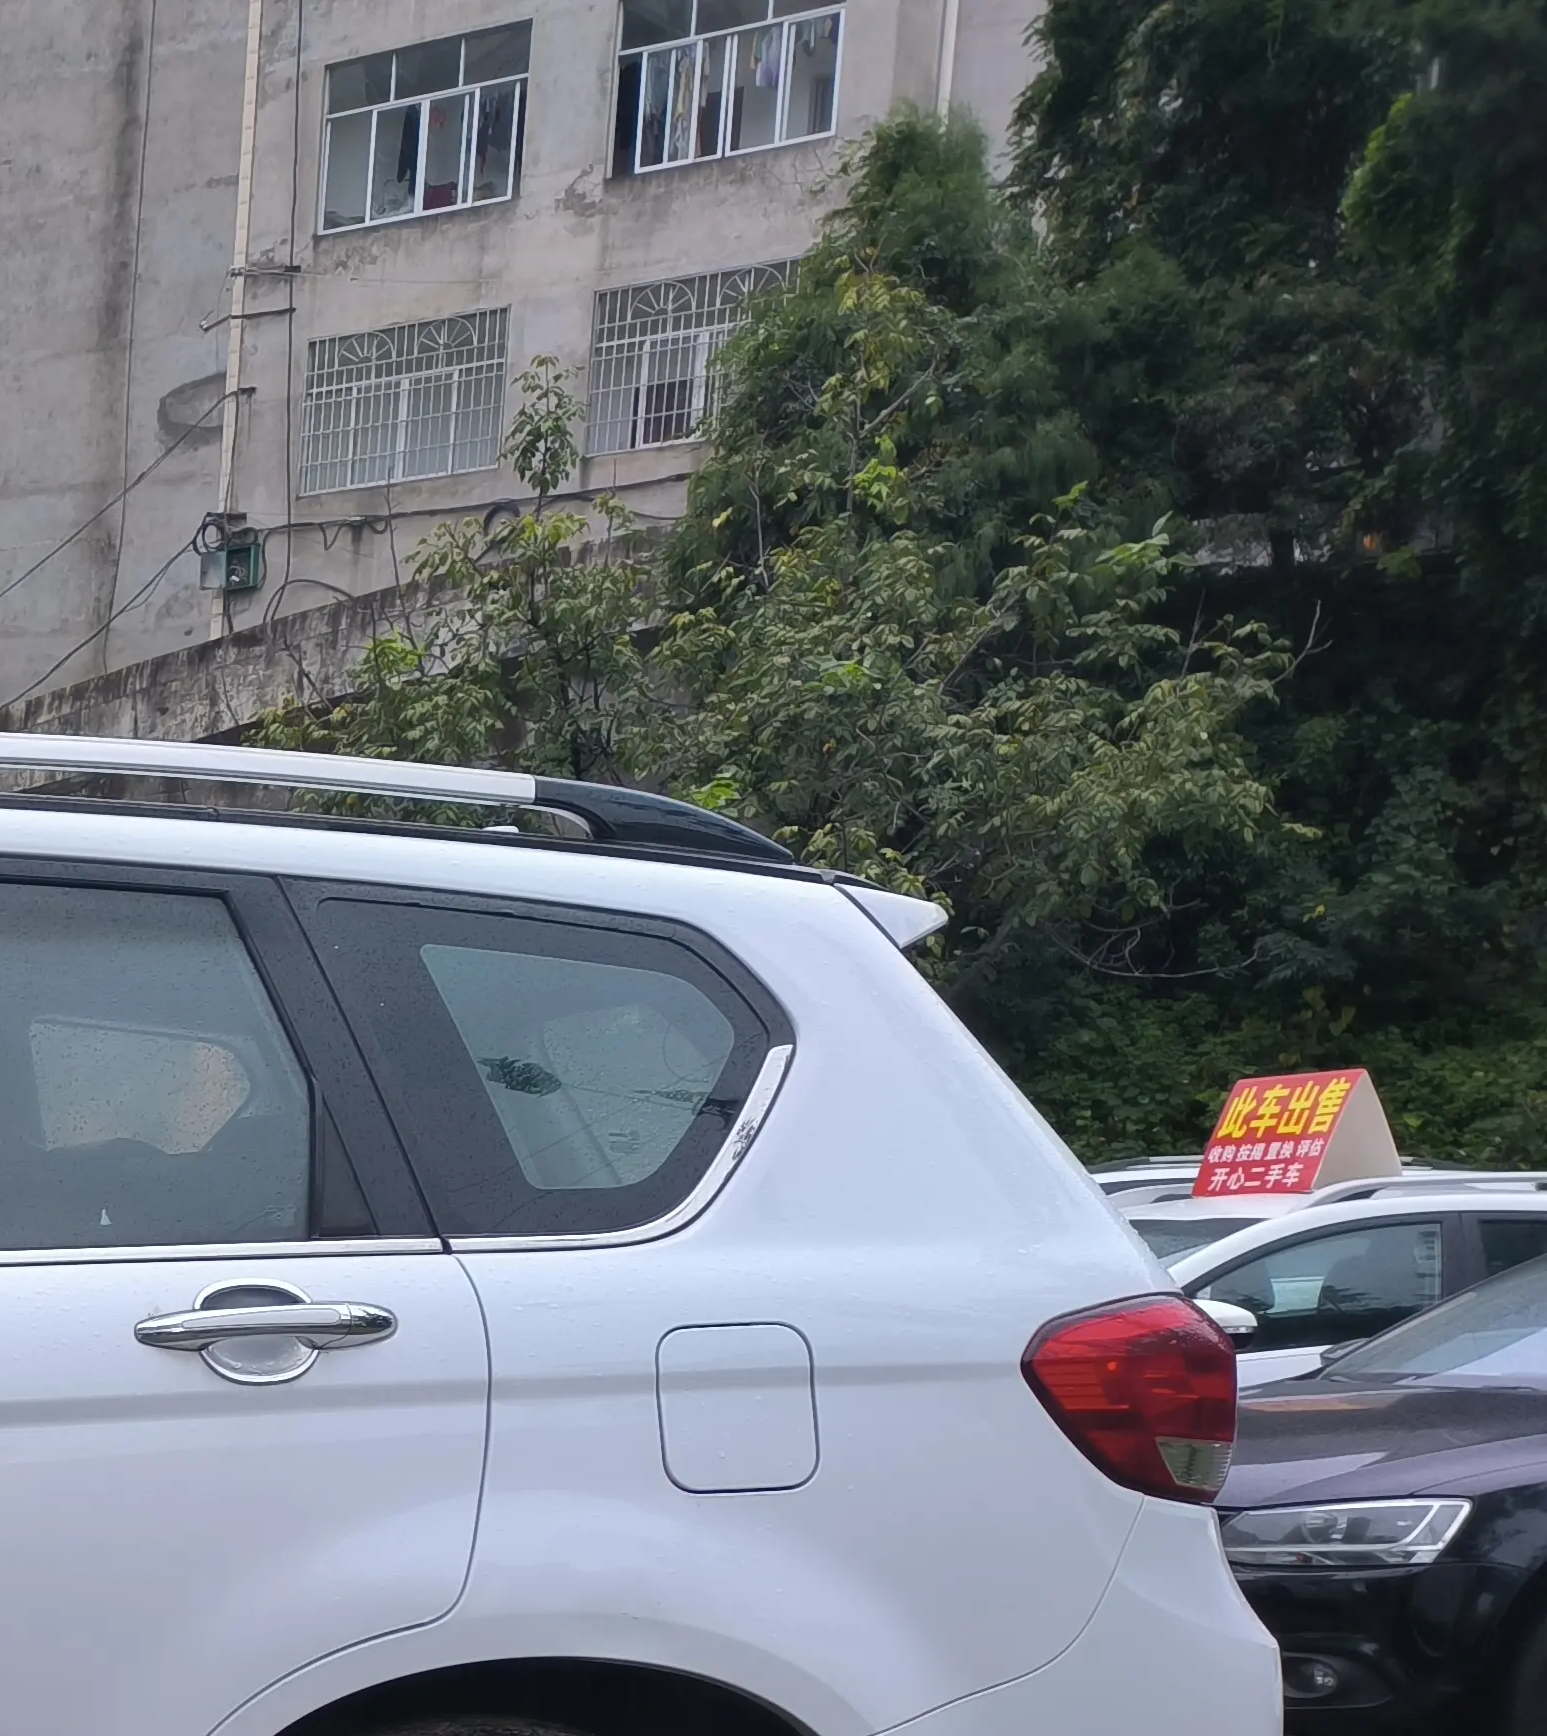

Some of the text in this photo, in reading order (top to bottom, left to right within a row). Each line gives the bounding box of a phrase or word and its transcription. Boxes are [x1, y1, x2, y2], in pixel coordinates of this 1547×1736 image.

[1216, 1076, 1352, 1139] 此车出售
[1207, 1162, 1304, 1191] 开心二手车
